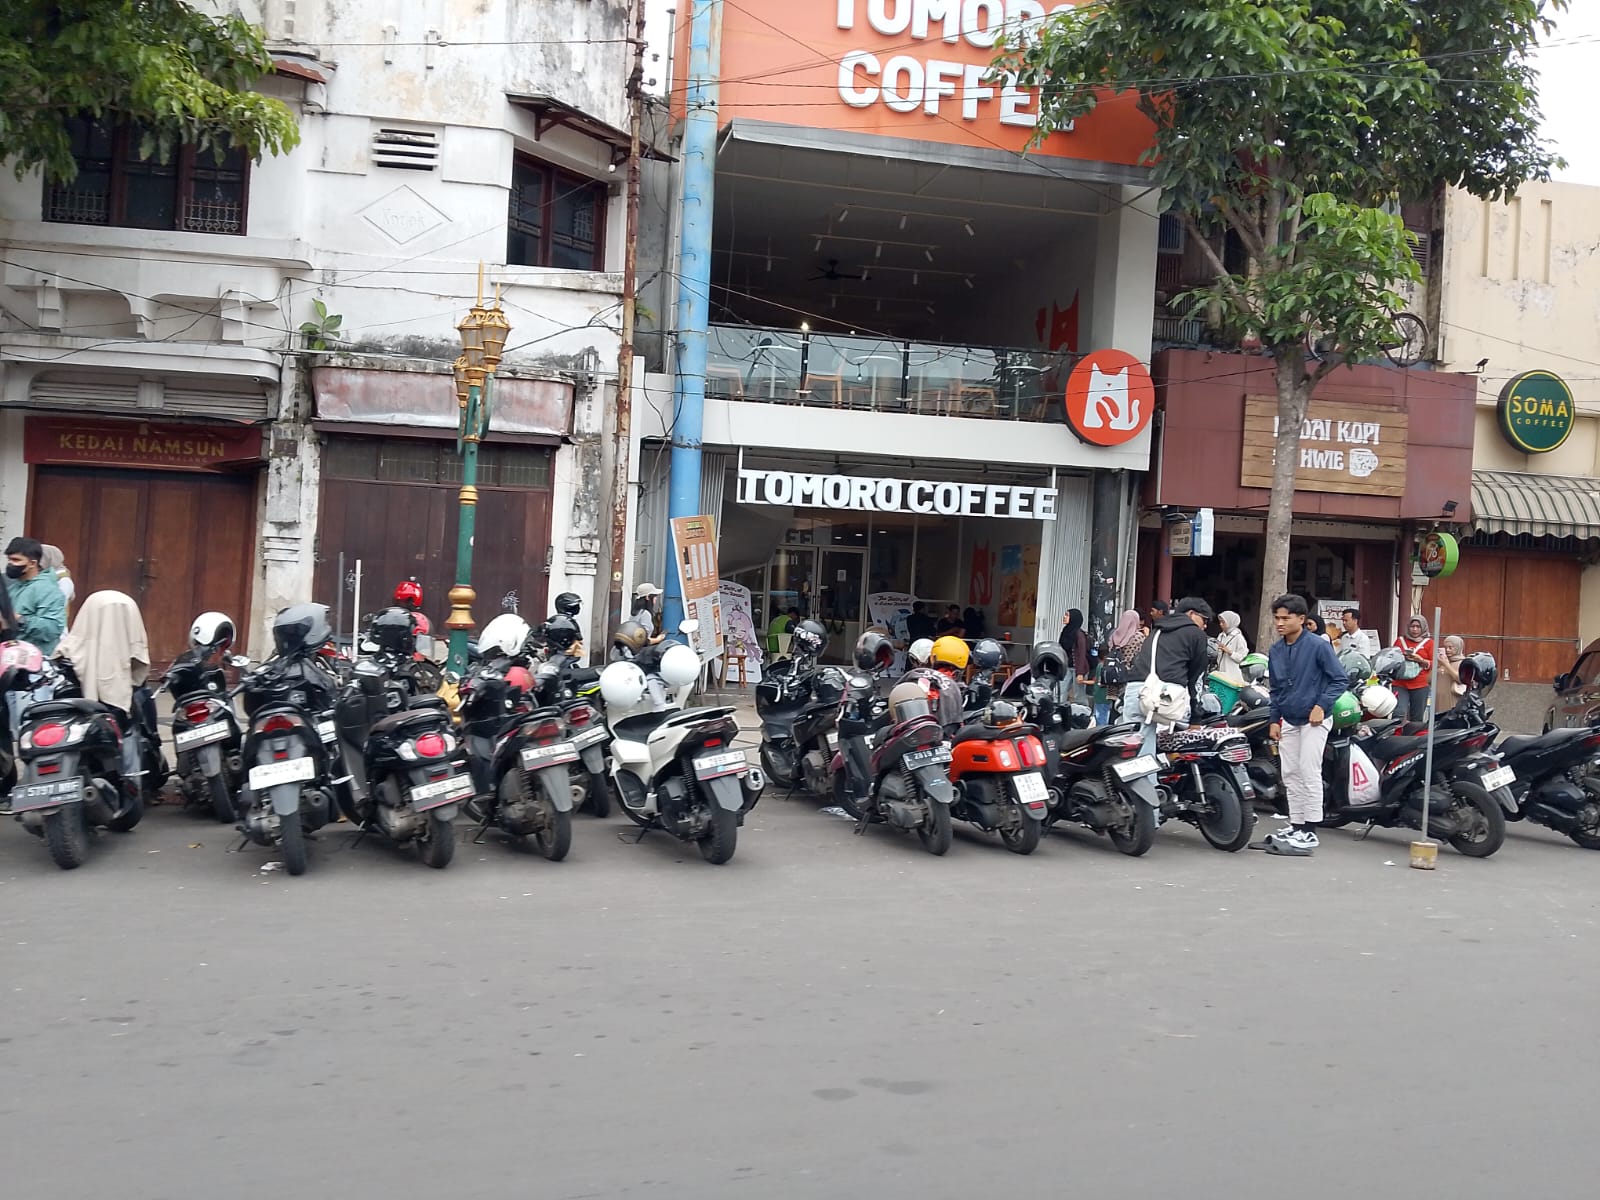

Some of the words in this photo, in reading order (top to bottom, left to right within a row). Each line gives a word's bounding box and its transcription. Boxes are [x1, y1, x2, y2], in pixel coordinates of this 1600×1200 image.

[1512, 395, 1568, 417] SOMA
[1273, 416, 1332, 441] DAI
[1337, 420, 1381, 445] KOPI
[1516, 417, 1565, 428] COFFEE
[60, 434, 124, 450] KEDAI
[133, 437, 225, 457] NAMSUN
[738, 470, 900, 511] TOMORO
[907, 480, 1057, 519] COFFEE
